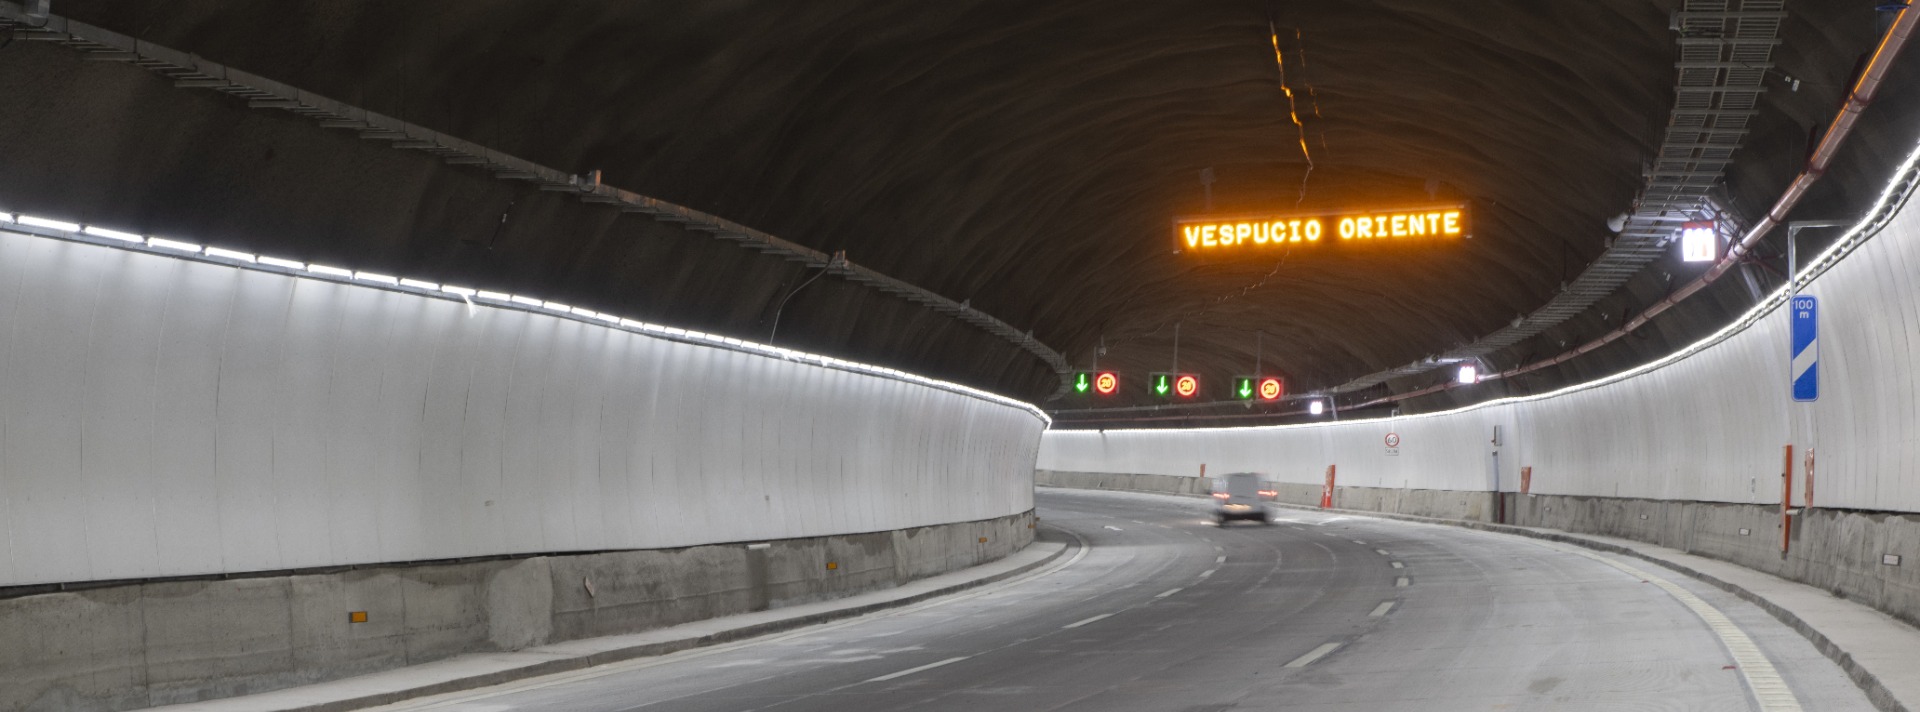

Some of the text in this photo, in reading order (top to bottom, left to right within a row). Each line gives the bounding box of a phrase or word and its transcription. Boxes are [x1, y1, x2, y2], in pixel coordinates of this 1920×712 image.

[1185, 212, 1460, 247] VESPUCIO ORIENTE
[1795, 300, 1813, 310] 100
[1799, 311, 1809, 319] m
